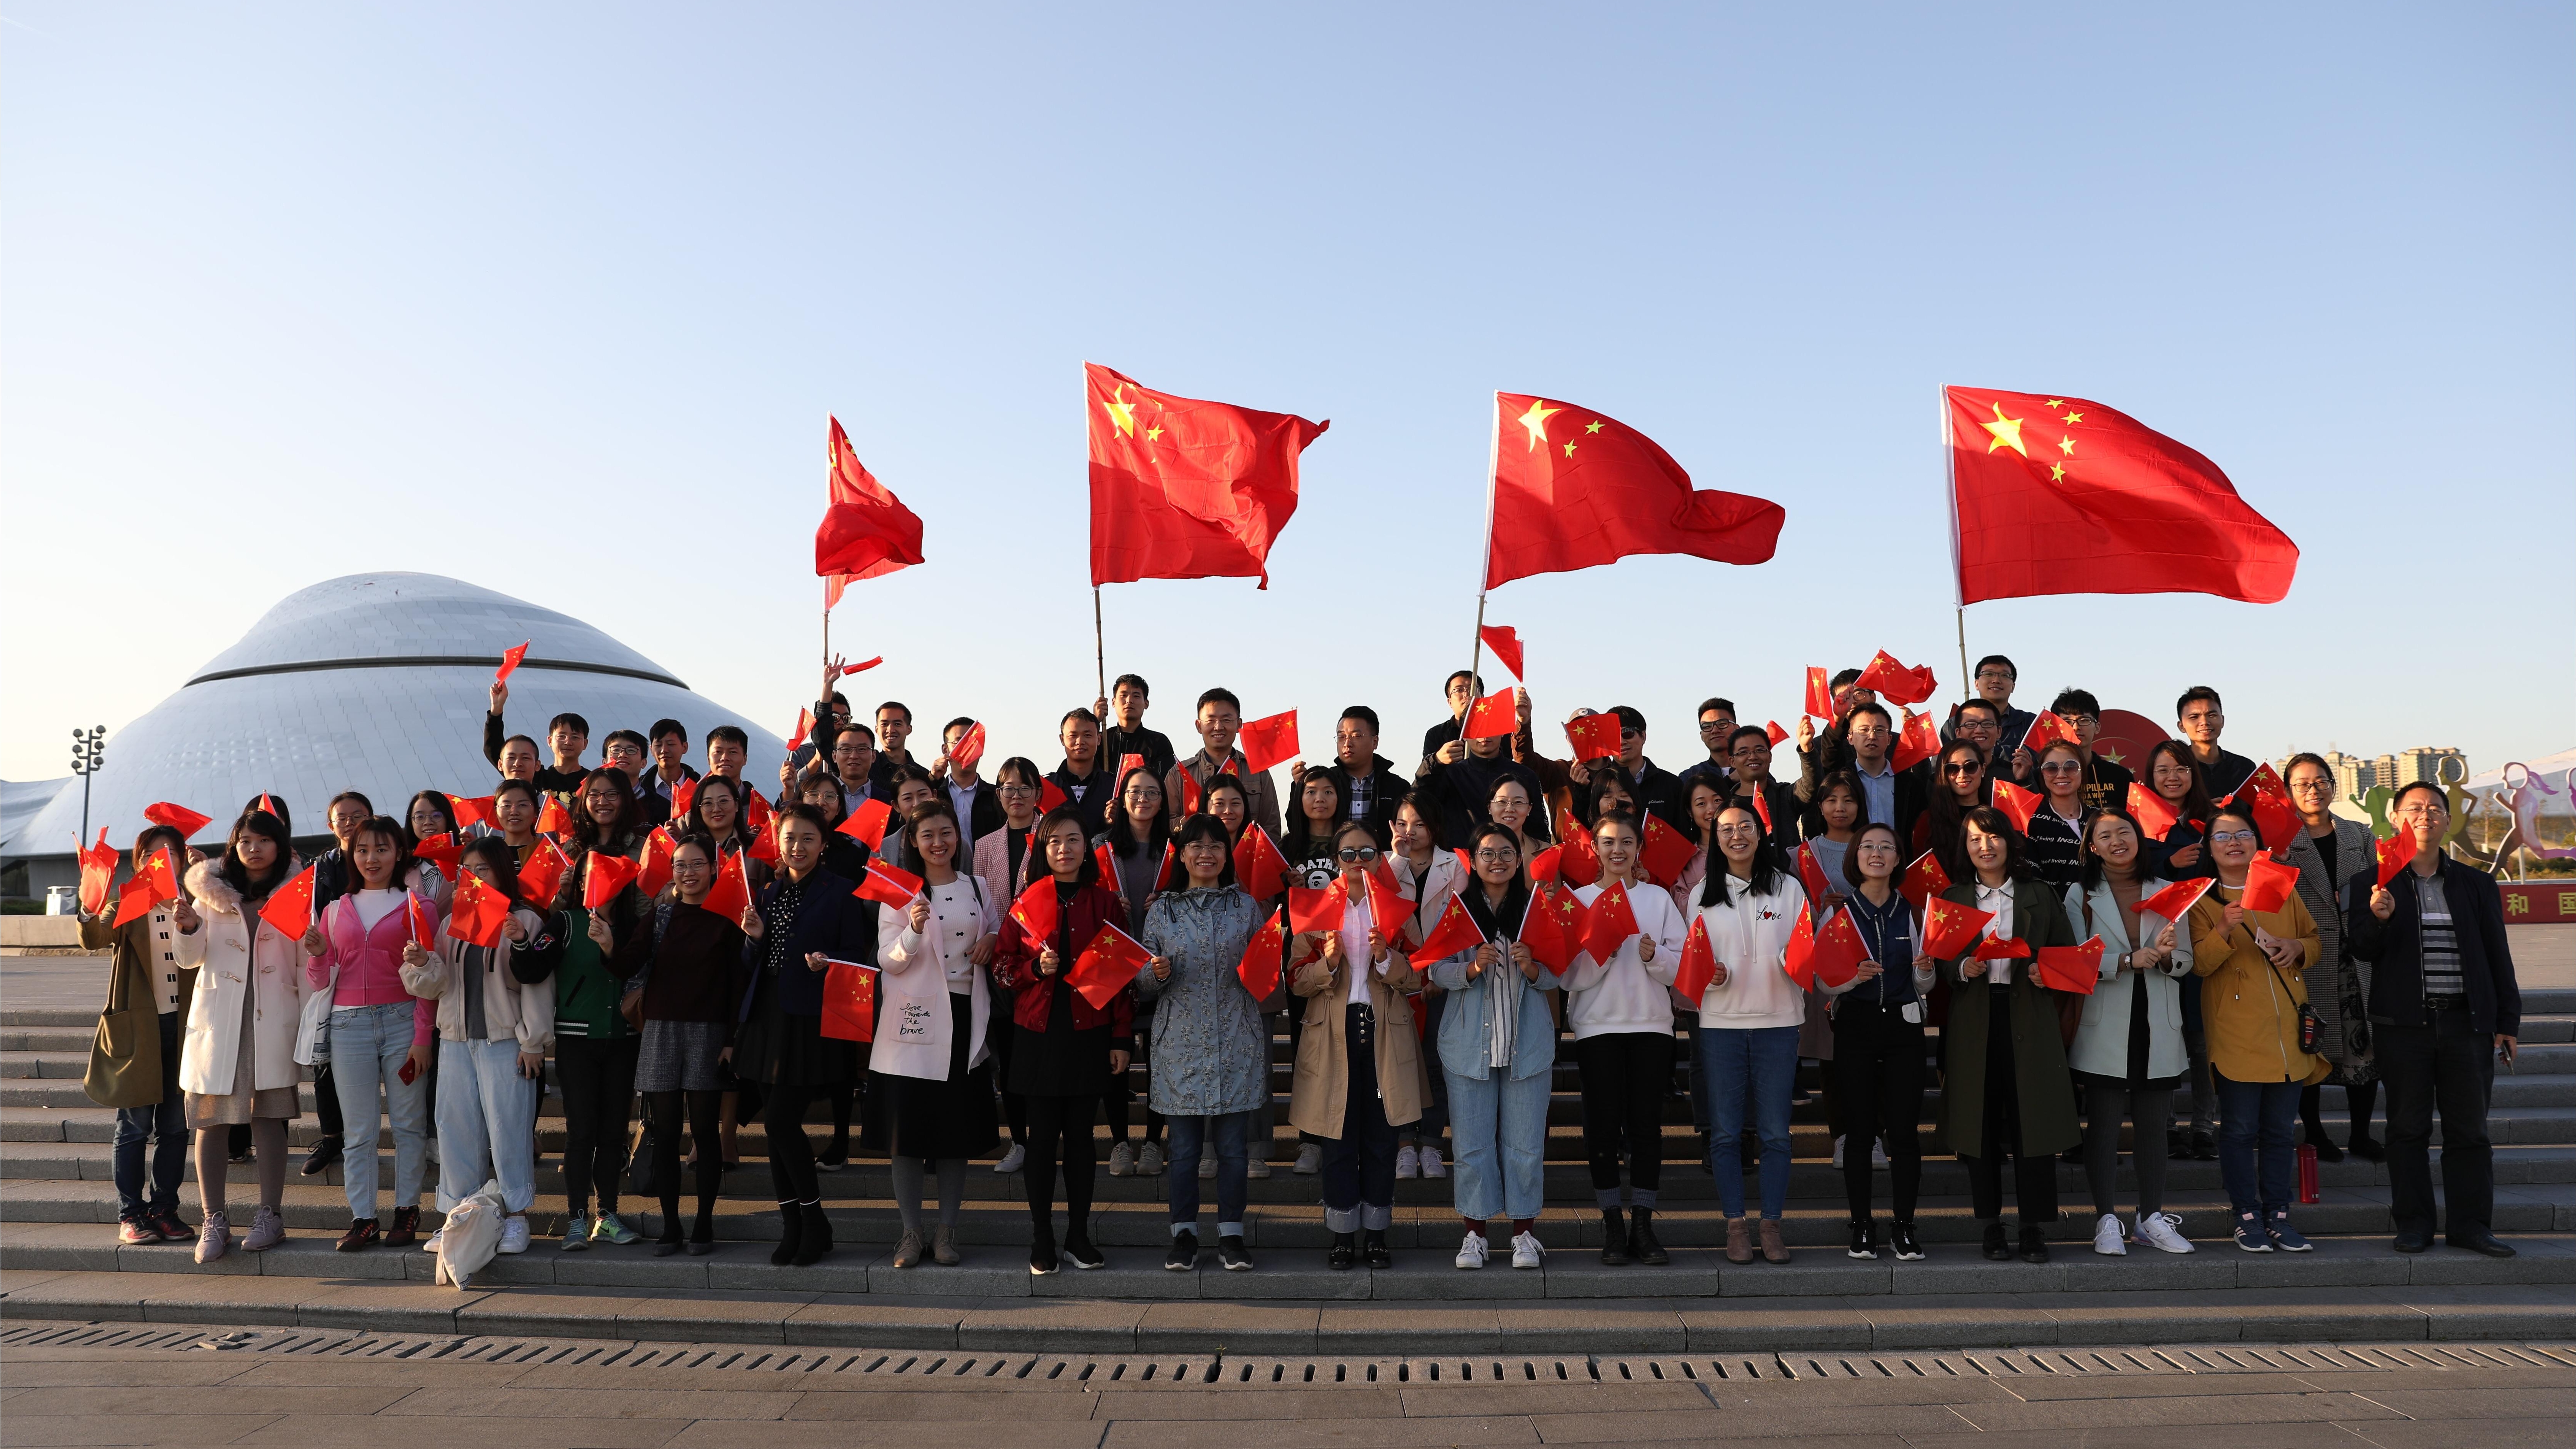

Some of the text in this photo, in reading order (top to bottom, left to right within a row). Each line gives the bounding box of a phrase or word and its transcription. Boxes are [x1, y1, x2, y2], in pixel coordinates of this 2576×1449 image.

[899, 1002, 922, 1012] love
[904, 1017, 920, 1025] the
[900, 1024, 925, 1035] brave
